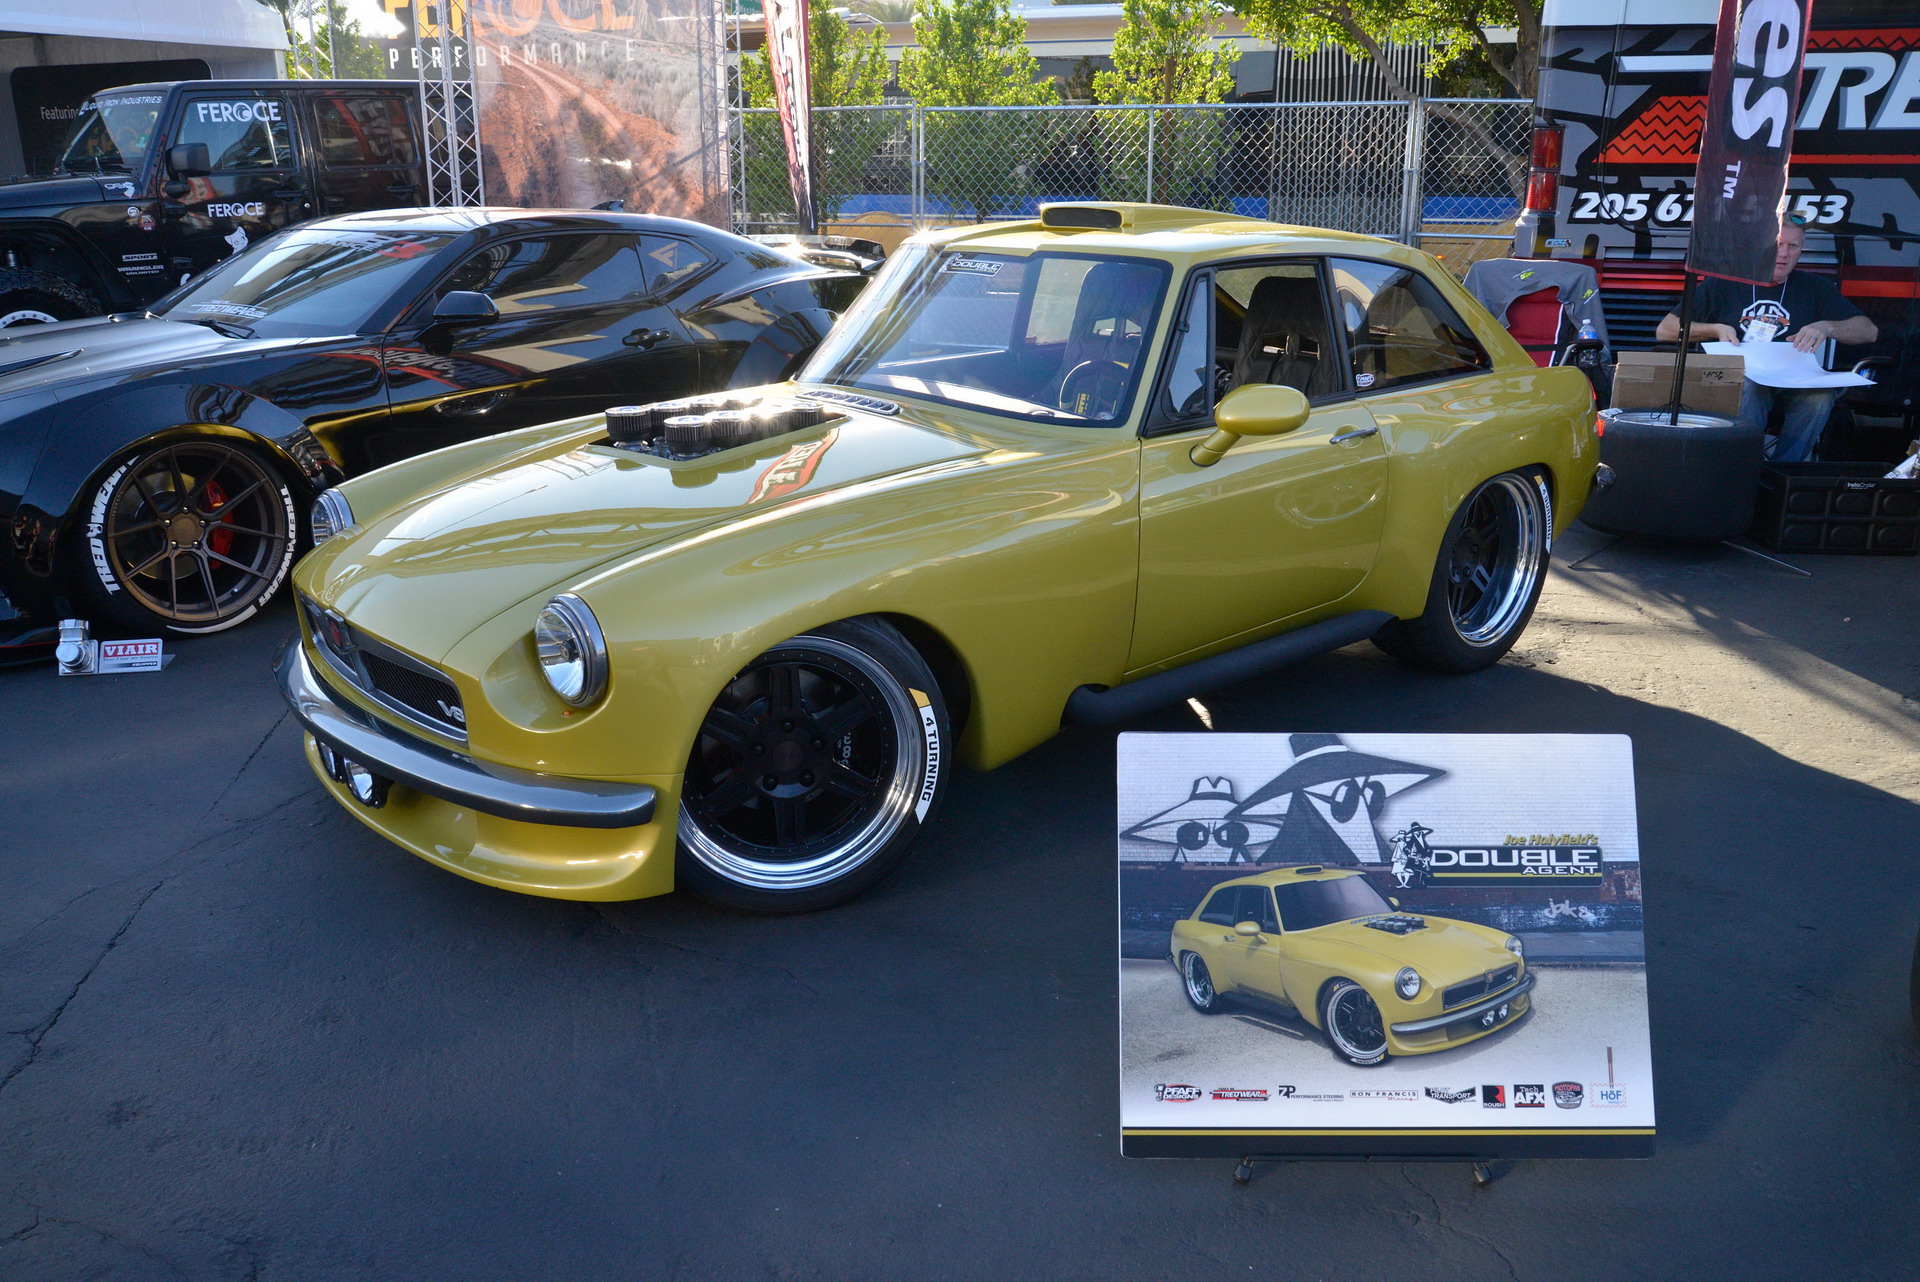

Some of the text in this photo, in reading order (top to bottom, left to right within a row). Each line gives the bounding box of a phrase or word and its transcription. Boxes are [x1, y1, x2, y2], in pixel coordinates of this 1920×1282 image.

[388, 39, 635, 70] PERFORMANCE
[120, 96, 162, 106] INDUSTRIES
[197, 102, 281, 123] FEROCE
[1722, 160, 1742, 199] TM
[207, 202, 265, 218] FEROCE
[1573, 192, 1650, 222] 205
[117, 264, 165, 273] WRANGLER
[953, 261, 1000, 270] DOUBLE
[104, 643, 158, 656] VIAIR
[437, 700, 465, 723] V8
[922, 717, 938, 802] 4 TURNING
[1503, 833, 1599, 847] Joe Holyfield's
[1429, 849, 1598, 866] DOUBLE
[1522, 866, 1599, 875] AGENT
[1164, 1087, 1200, 1095] PFAFF
[1514, 1092, 1545, 1104] AFX
